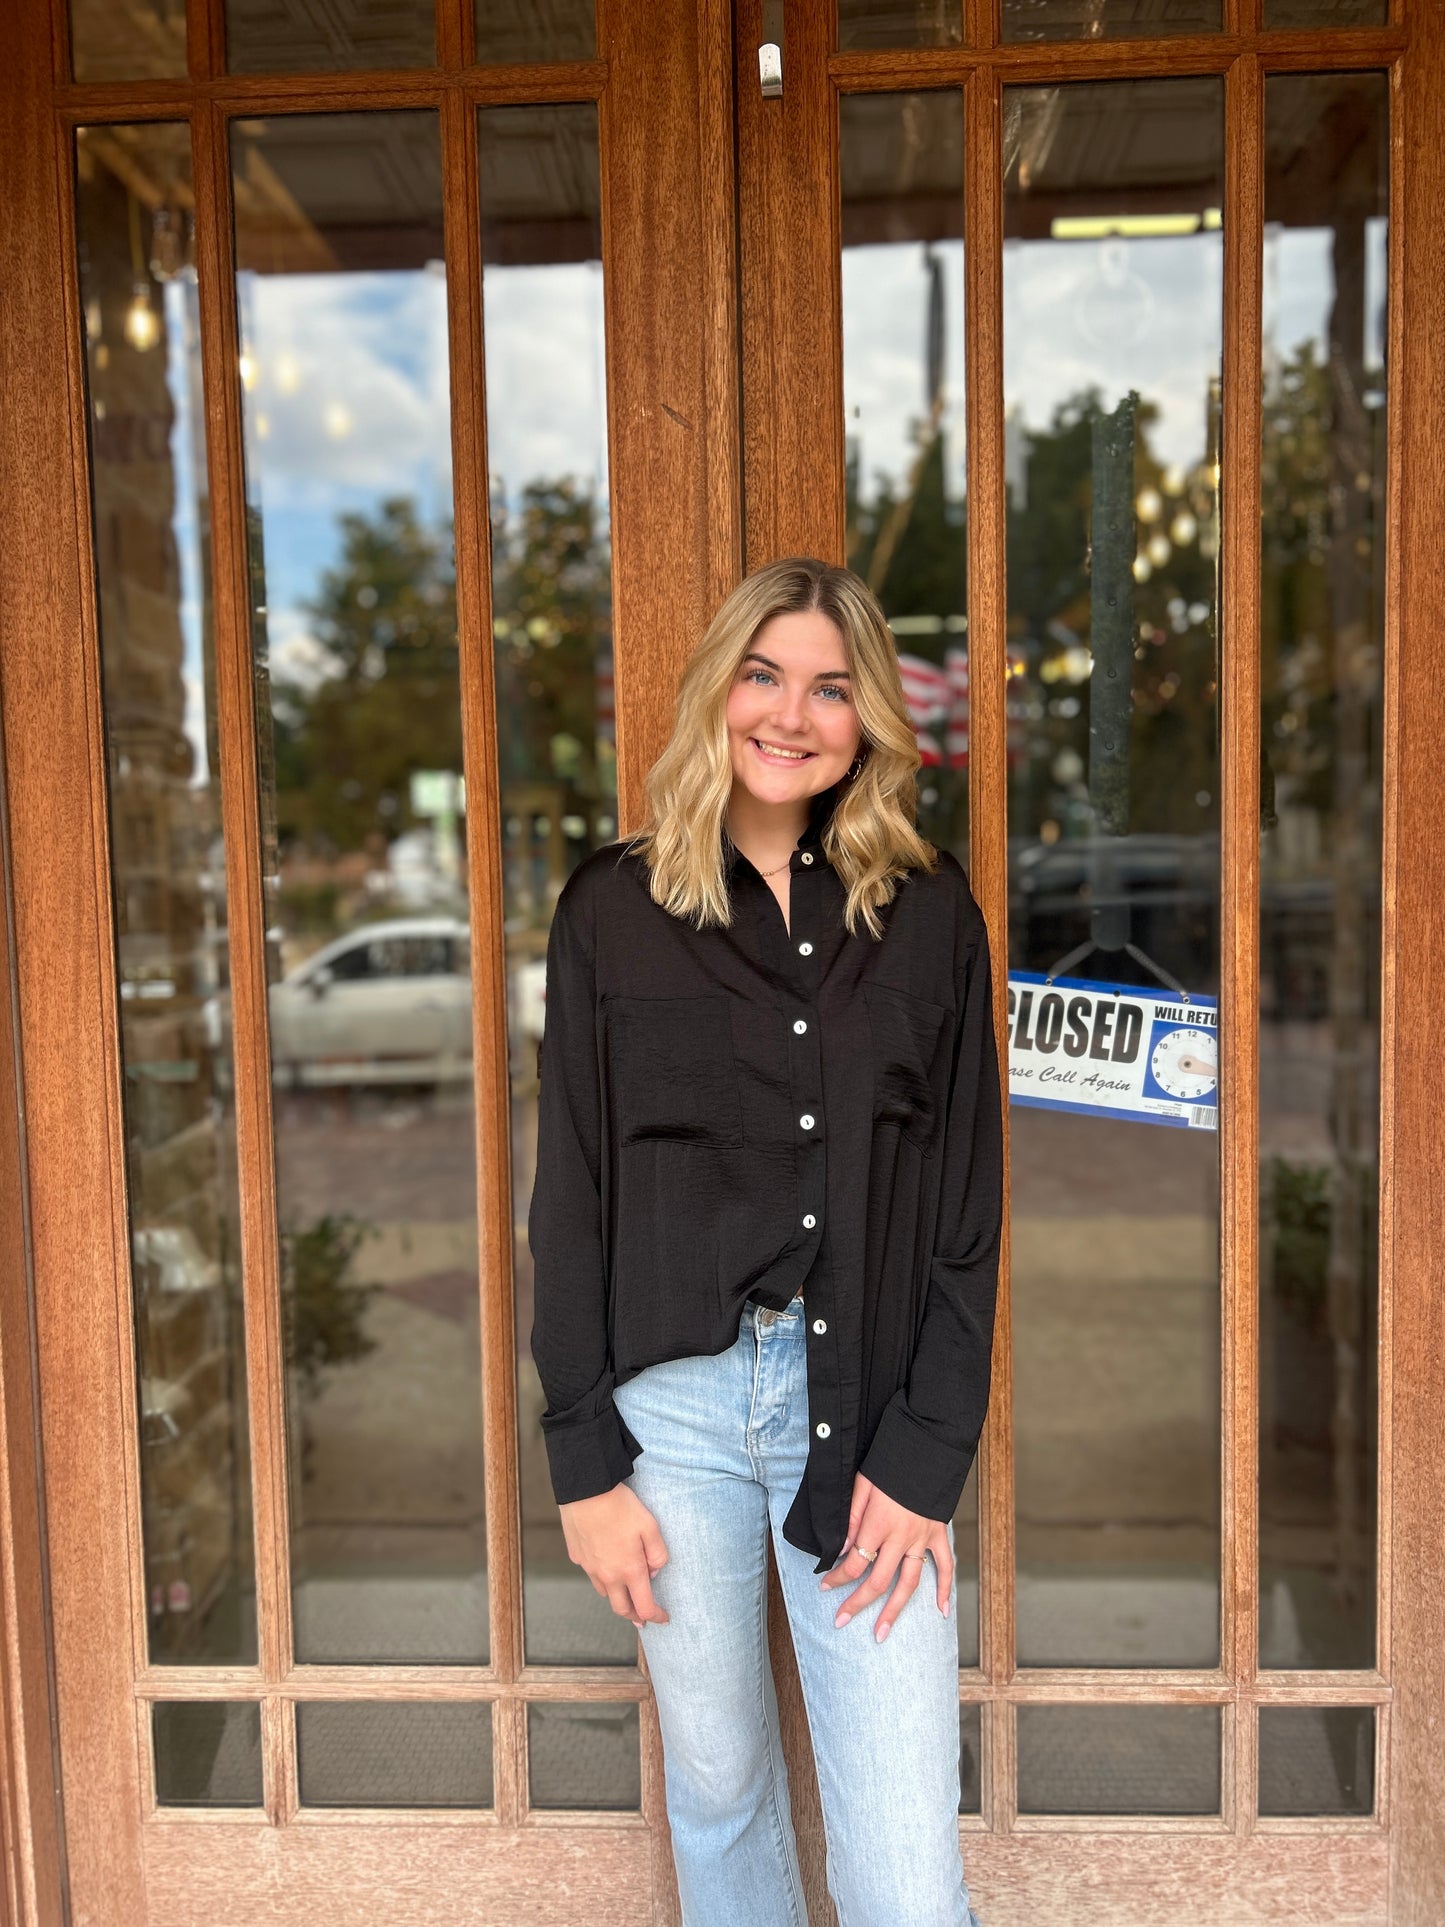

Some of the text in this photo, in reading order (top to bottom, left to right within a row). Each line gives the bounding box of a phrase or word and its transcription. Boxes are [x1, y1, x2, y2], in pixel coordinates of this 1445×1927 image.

[1154, 1006, 1184, 1022] WILL
[1187, 1030, 1198, 1038] 12
[1039, 1066, 1078, 1084] Call
[1080, 1073, 1132, 1092] Again
